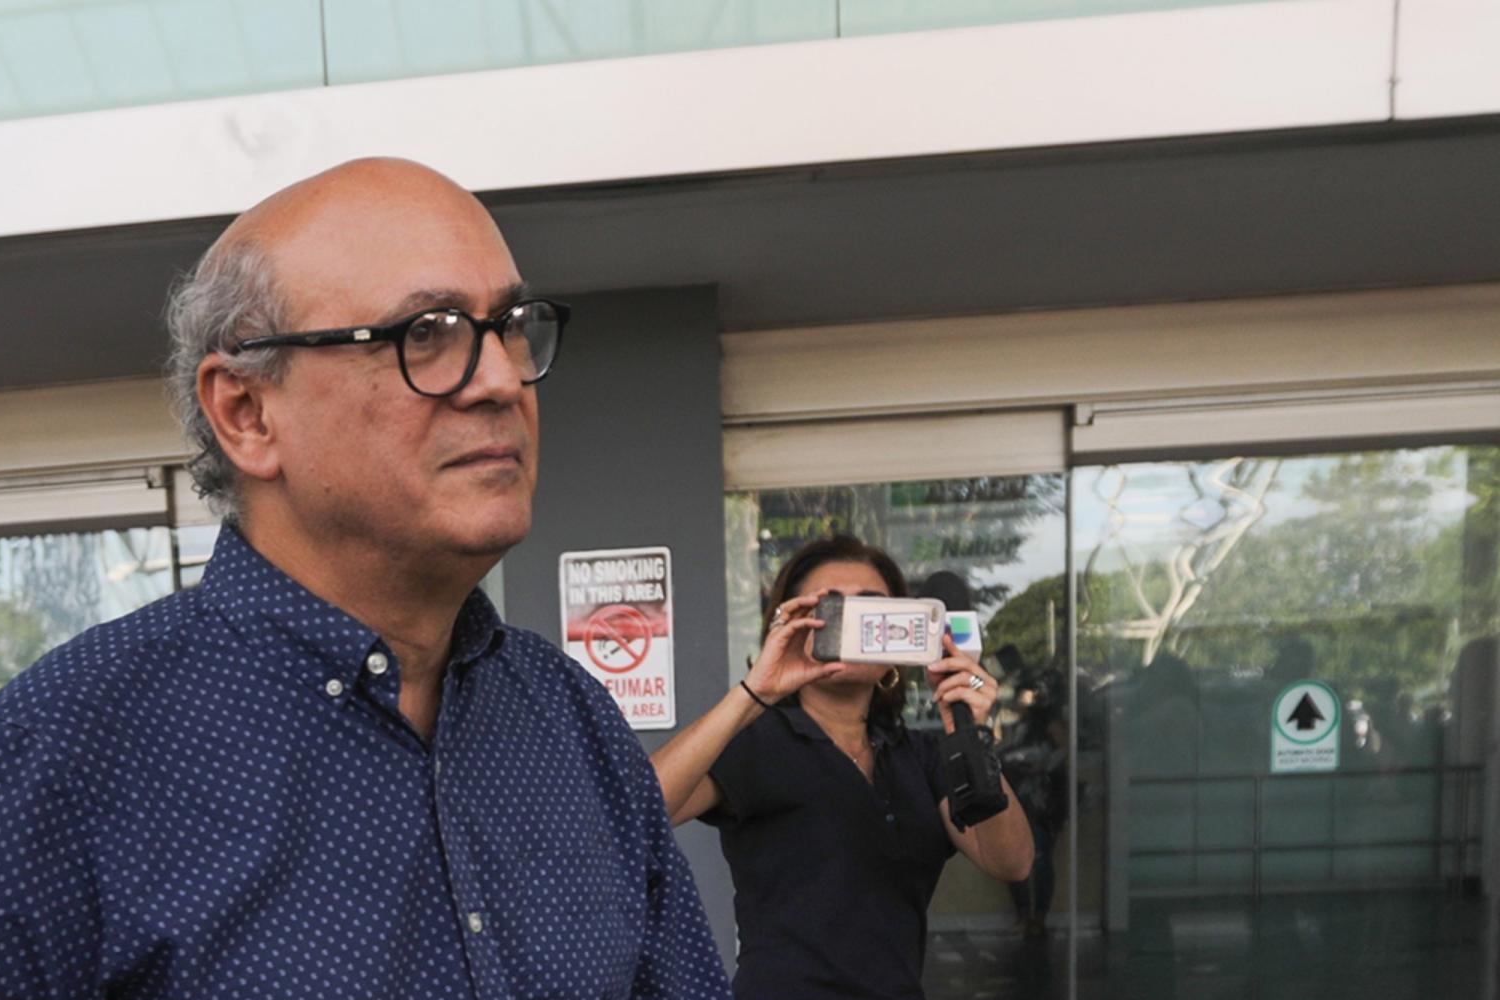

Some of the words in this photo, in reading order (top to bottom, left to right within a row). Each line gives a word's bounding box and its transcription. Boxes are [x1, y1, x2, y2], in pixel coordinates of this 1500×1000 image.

[568, 562, 591, 584] NO
[594, 557, 666, 583] SMOKING
[569, 587, 586, 605] IN
[588, 585, 622, 604] THIS
[625, 583, 667, 602] AREA
[605, 677, 666, 698] FUMAR
[632, 703, 666, 716] AREA
